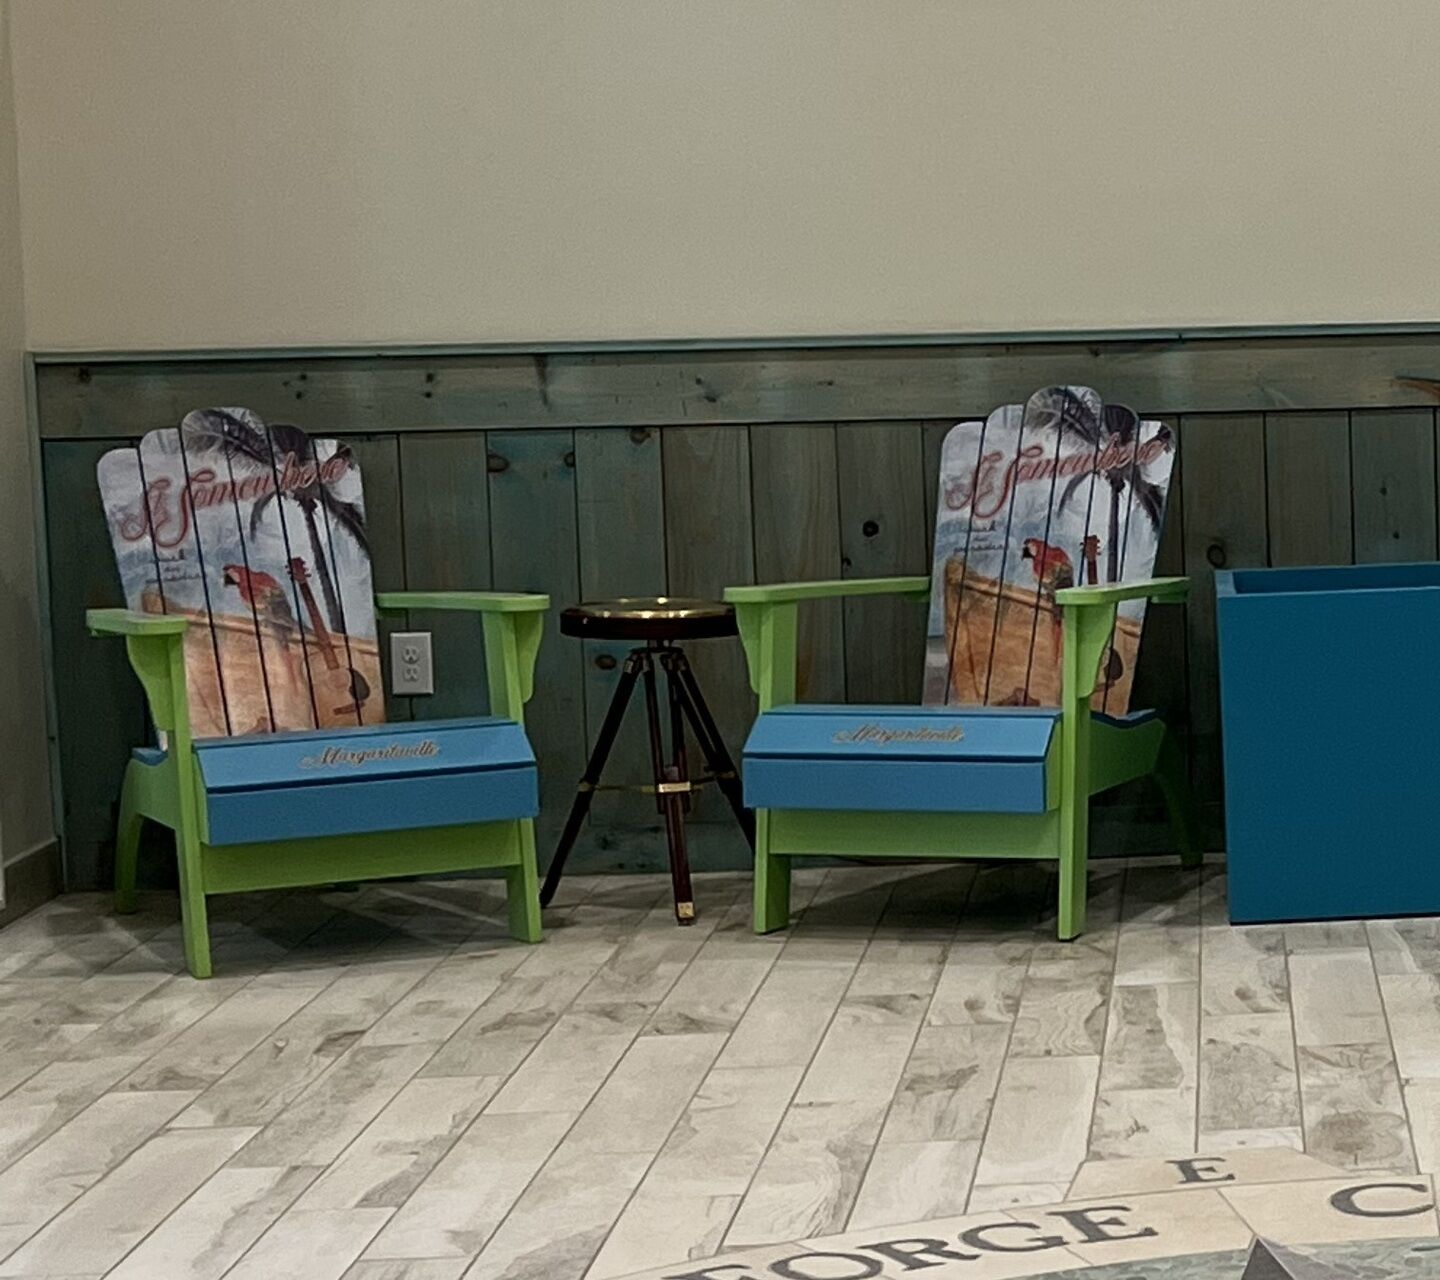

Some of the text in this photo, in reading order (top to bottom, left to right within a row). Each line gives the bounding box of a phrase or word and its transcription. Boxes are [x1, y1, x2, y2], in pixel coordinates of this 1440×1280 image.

[832, 723, 965, 748] Margaritaville
[299, 738, 439, 770] Margaritaville
[1165, 1157, 1236, 1184] E
